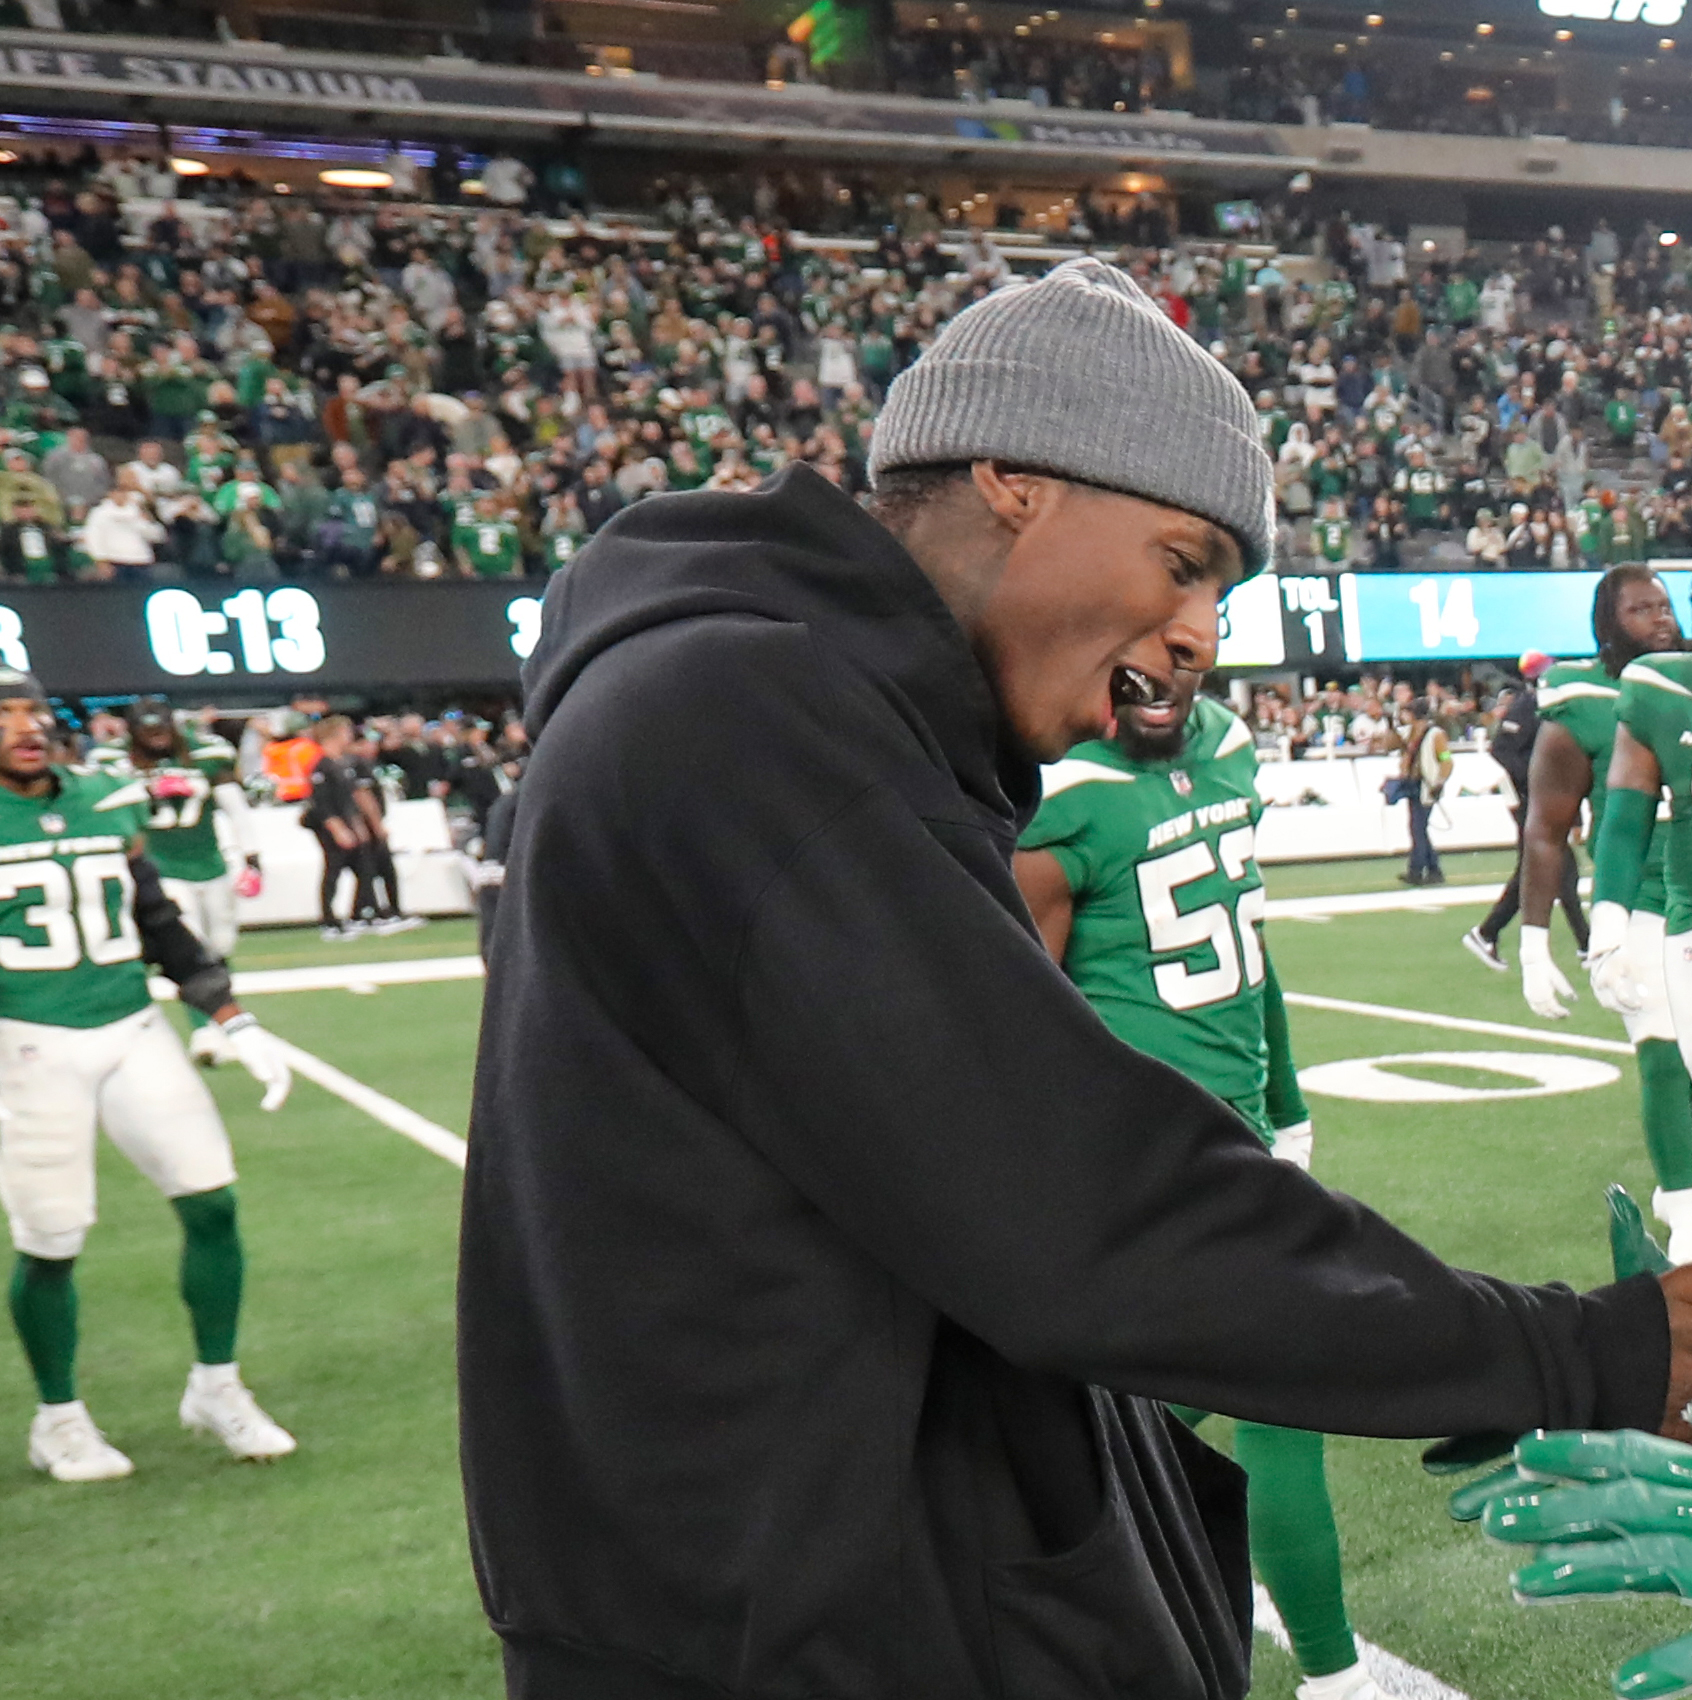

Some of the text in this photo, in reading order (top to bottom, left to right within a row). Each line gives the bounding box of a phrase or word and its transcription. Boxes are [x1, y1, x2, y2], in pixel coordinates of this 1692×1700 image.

[120, 58, 424, 104] STADIUM
[144, 587, 327, 675] 0:13
[1303, 611, 1325, 654] 1
[1409, 578, 1480, 648] 14
[1147, 810, 1195, 851] NEW
[0, 851, 143, 971] 30
